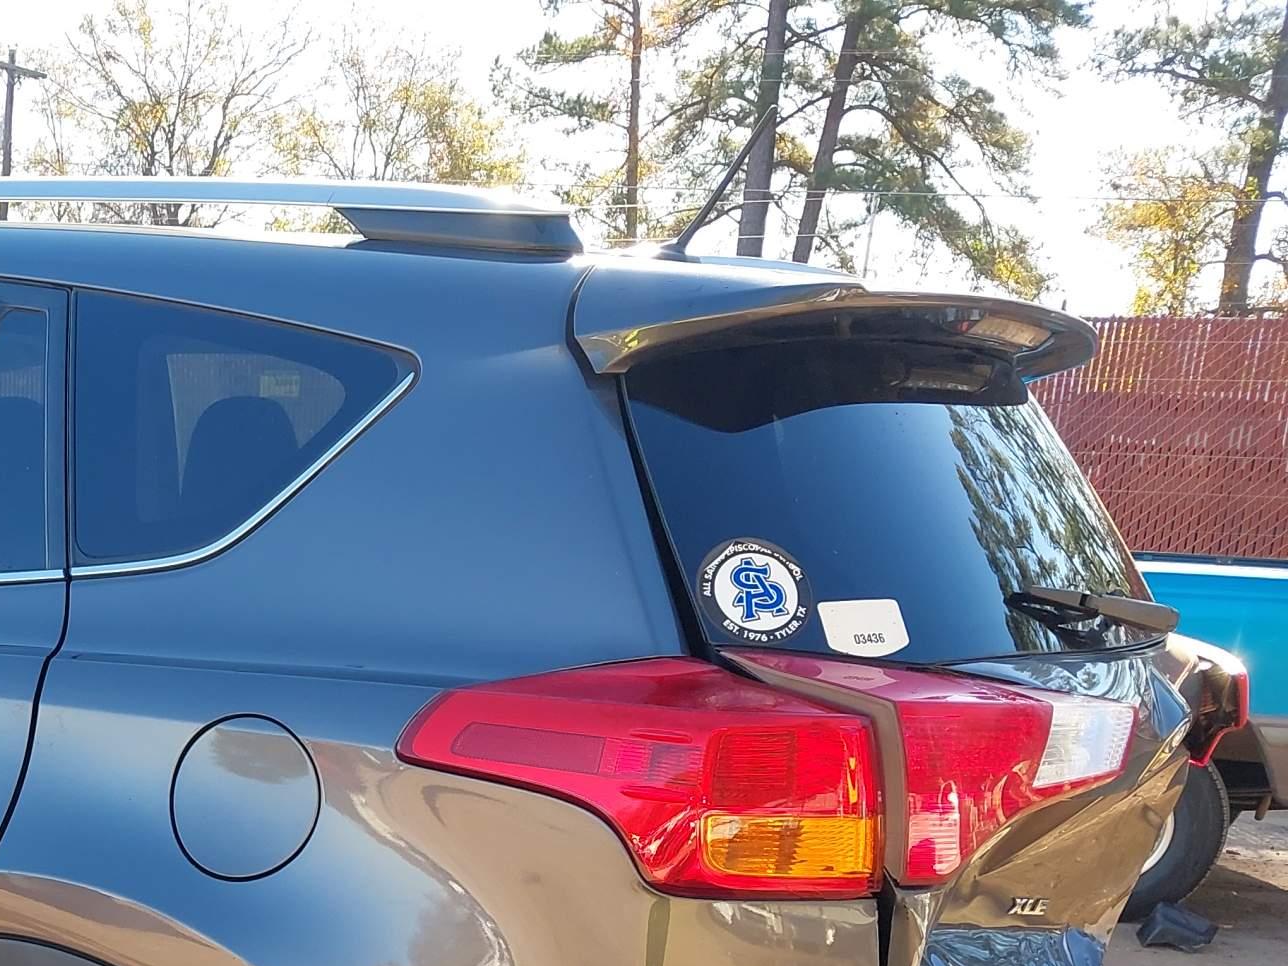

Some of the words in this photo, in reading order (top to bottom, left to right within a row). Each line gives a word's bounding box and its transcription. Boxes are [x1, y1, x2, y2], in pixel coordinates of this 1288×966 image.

[702, 581, 712, 597] ALL
[722, 619, 740, 635] EST.
[743, 630, 768, 642] 1976
[774, 619, 803, 640] TYLER,
[796, 606, 807, 618] TX
[854, 632, 886, 645] 03436
[1007, 897, 1050, 916] XLE
